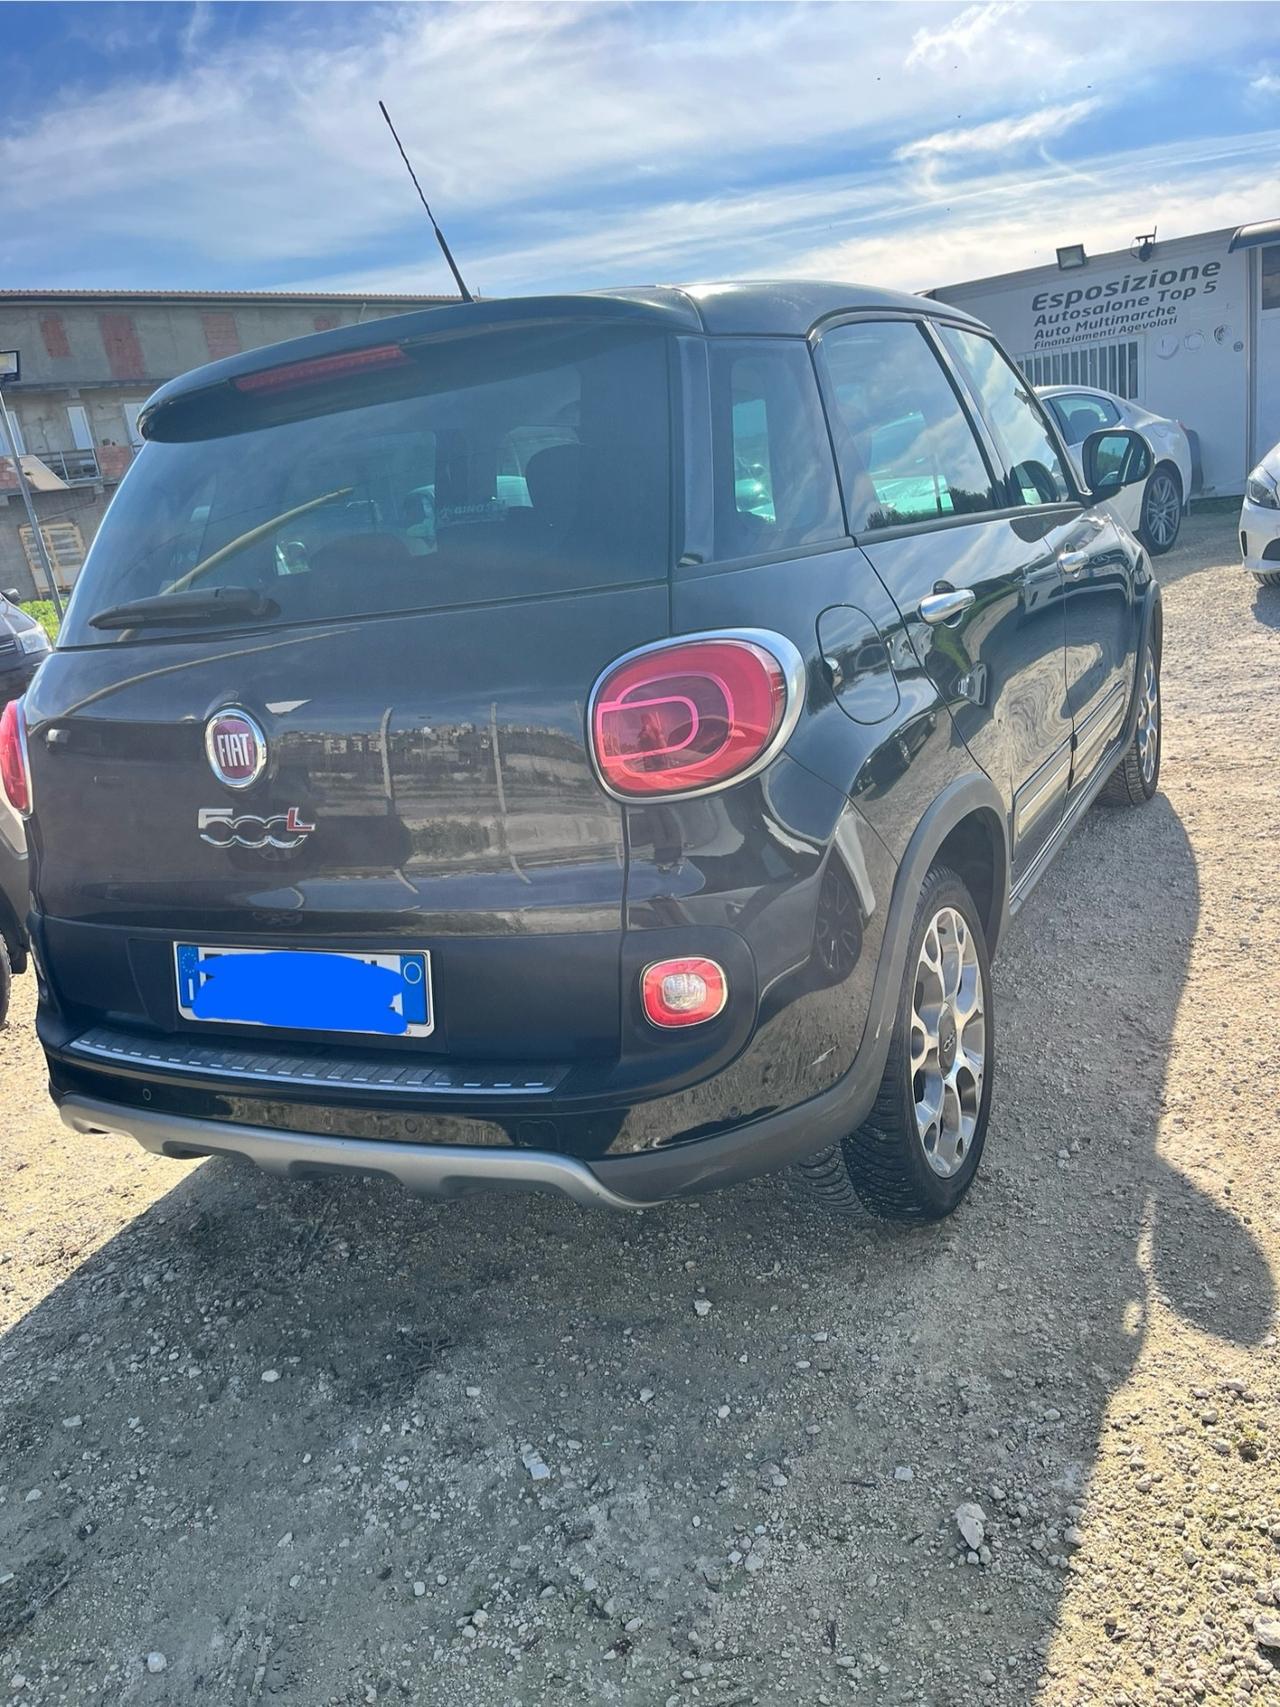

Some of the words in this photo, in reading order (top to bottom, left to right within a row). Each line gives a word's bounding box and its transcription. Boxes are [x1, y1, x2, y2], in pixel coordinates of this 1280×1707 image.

[1032, 261, 1221, 312] Esposizione
[1034, 295, 1150, 327] Autosalone
[1157, 287, 1196, 302] Top
[1203, 280, 1218, 294] 5
[1034, 325, 1070, 341] Auto
[1075, 304, 1177, 331] Multimarche
[1034, 328, 1116, 349] Finanziamenti
[1119, 316, 1178, 334] Agevolati
[216, 733, 250, 767] FIAT
[198, 807, 316, 849] 500L
